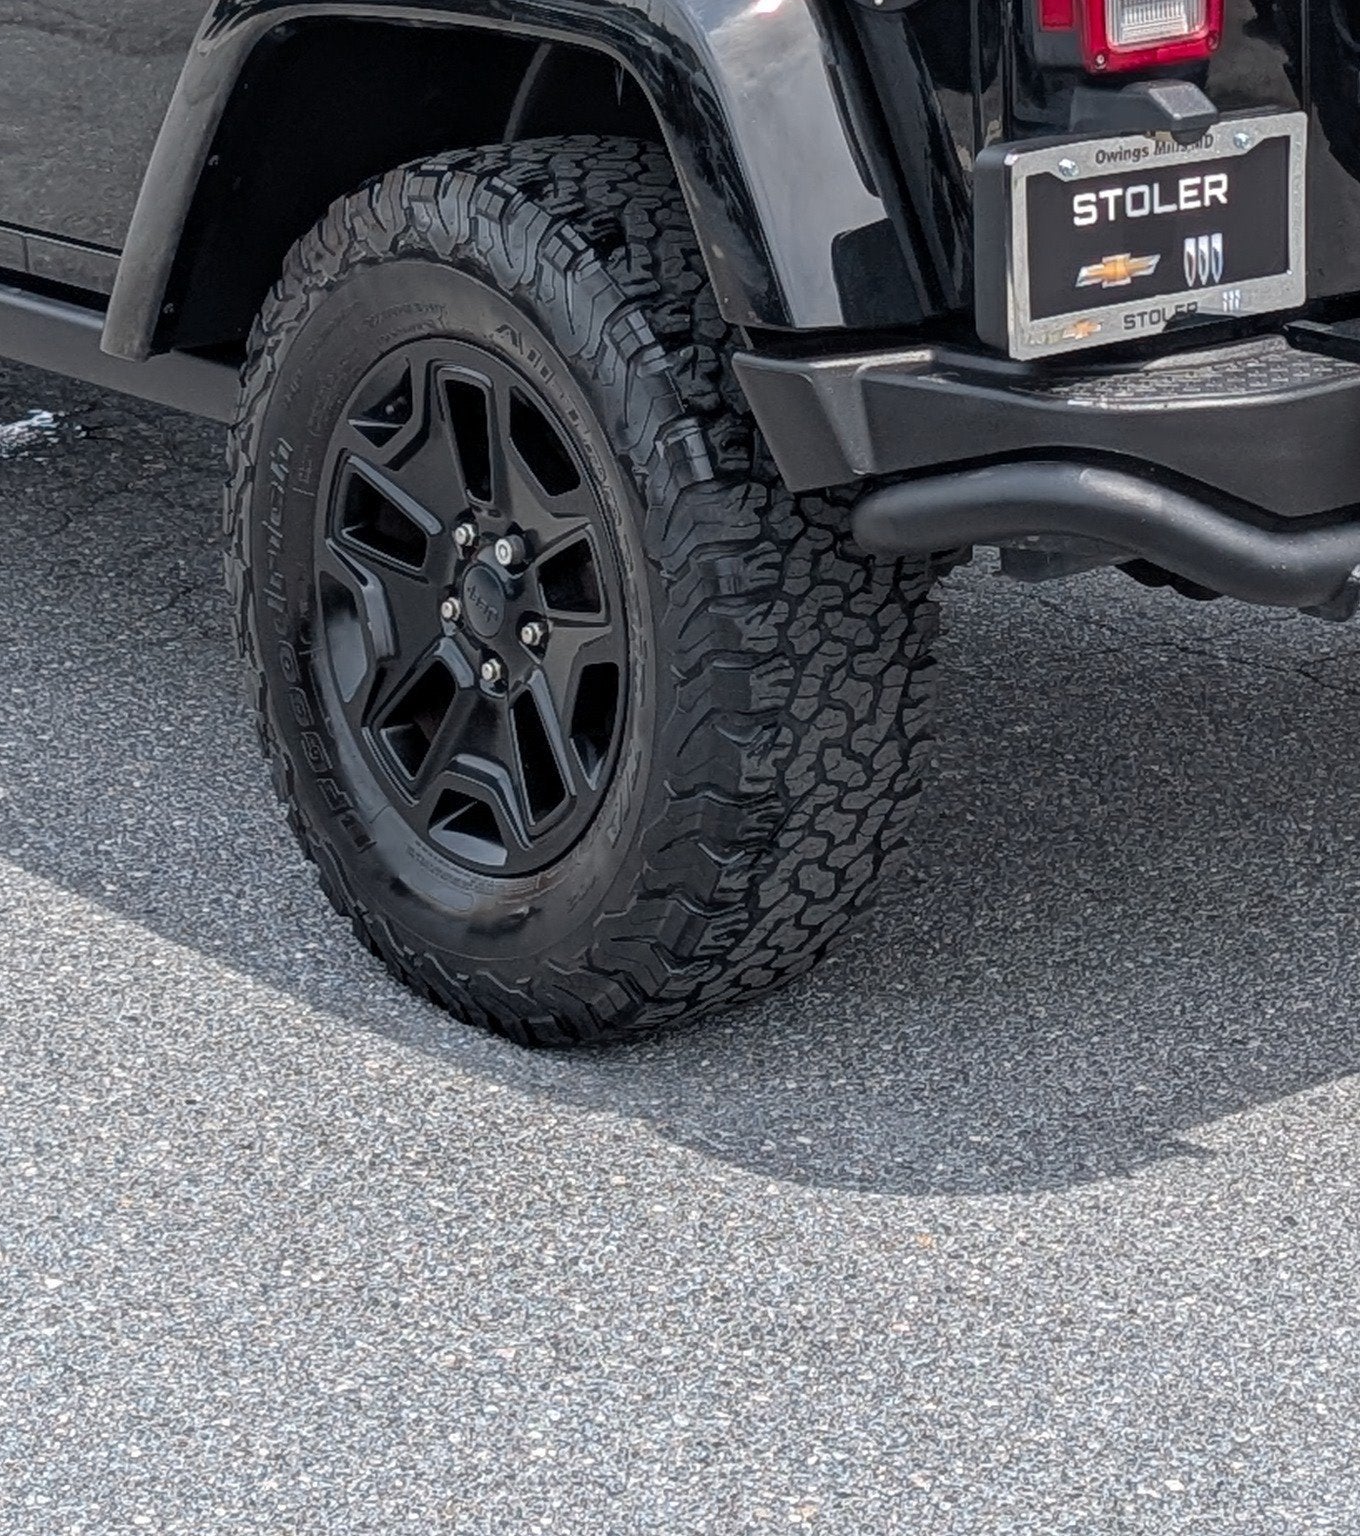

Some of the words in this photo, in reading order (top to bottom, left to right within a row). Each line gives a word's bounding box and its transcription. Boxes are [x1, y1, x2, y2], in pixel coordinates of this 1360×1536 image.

[1095, 145, 1149, 164] Owings
[1073, 173, 1229, 226] STOLER
[1123, 301, 1198, 330] STOLER
